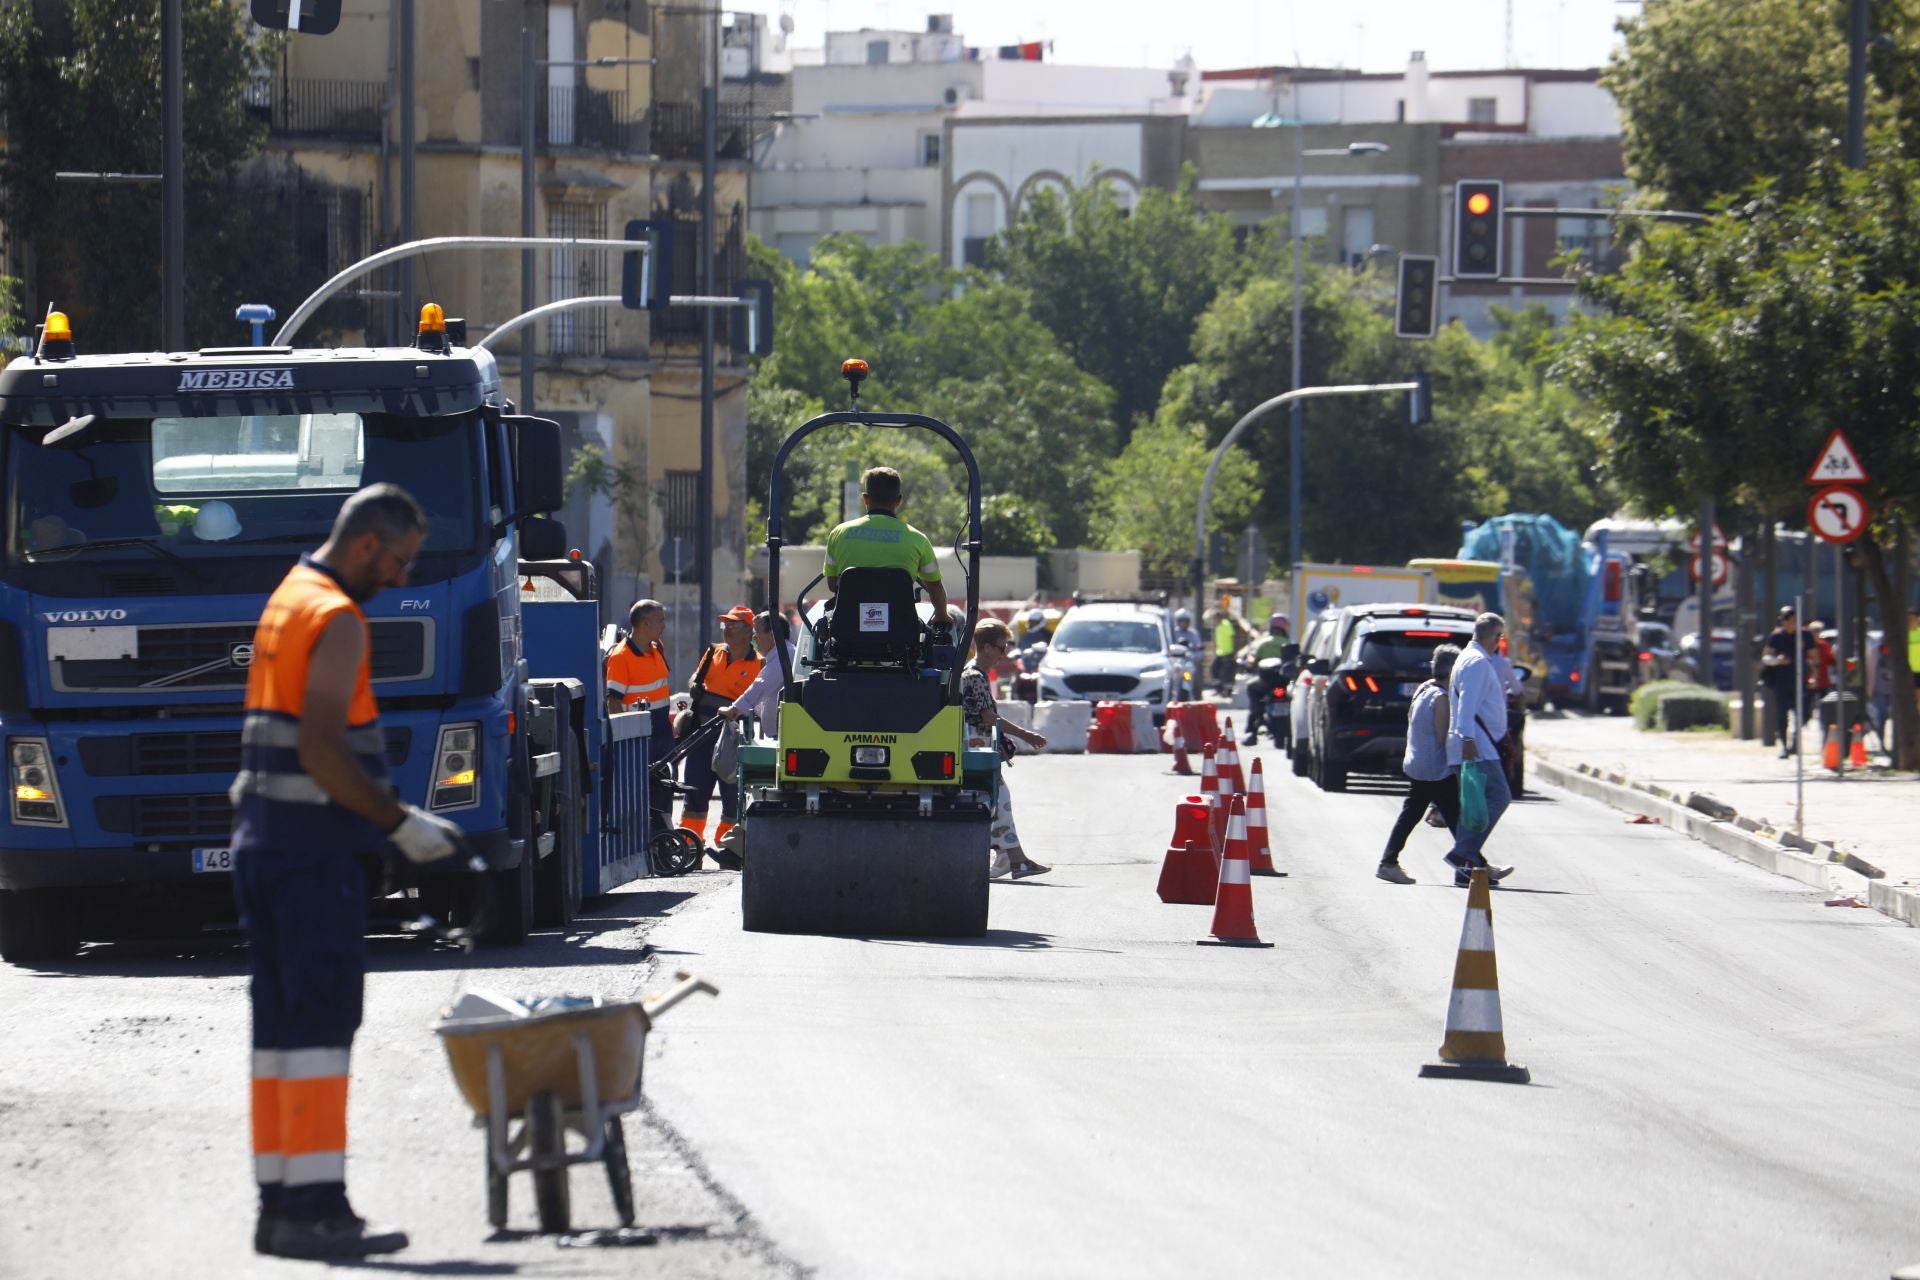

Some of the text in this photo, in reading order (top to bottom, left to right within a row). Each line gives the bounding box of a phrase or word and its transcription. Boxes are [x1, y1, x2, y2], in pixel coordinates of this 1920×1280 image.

[178, 370, 295, 389] MEBISA
[400, 599, 431, 610] FM
[43, 608, 127, 622] VOLVO
[843, 734, 897, 744] AMMANN
